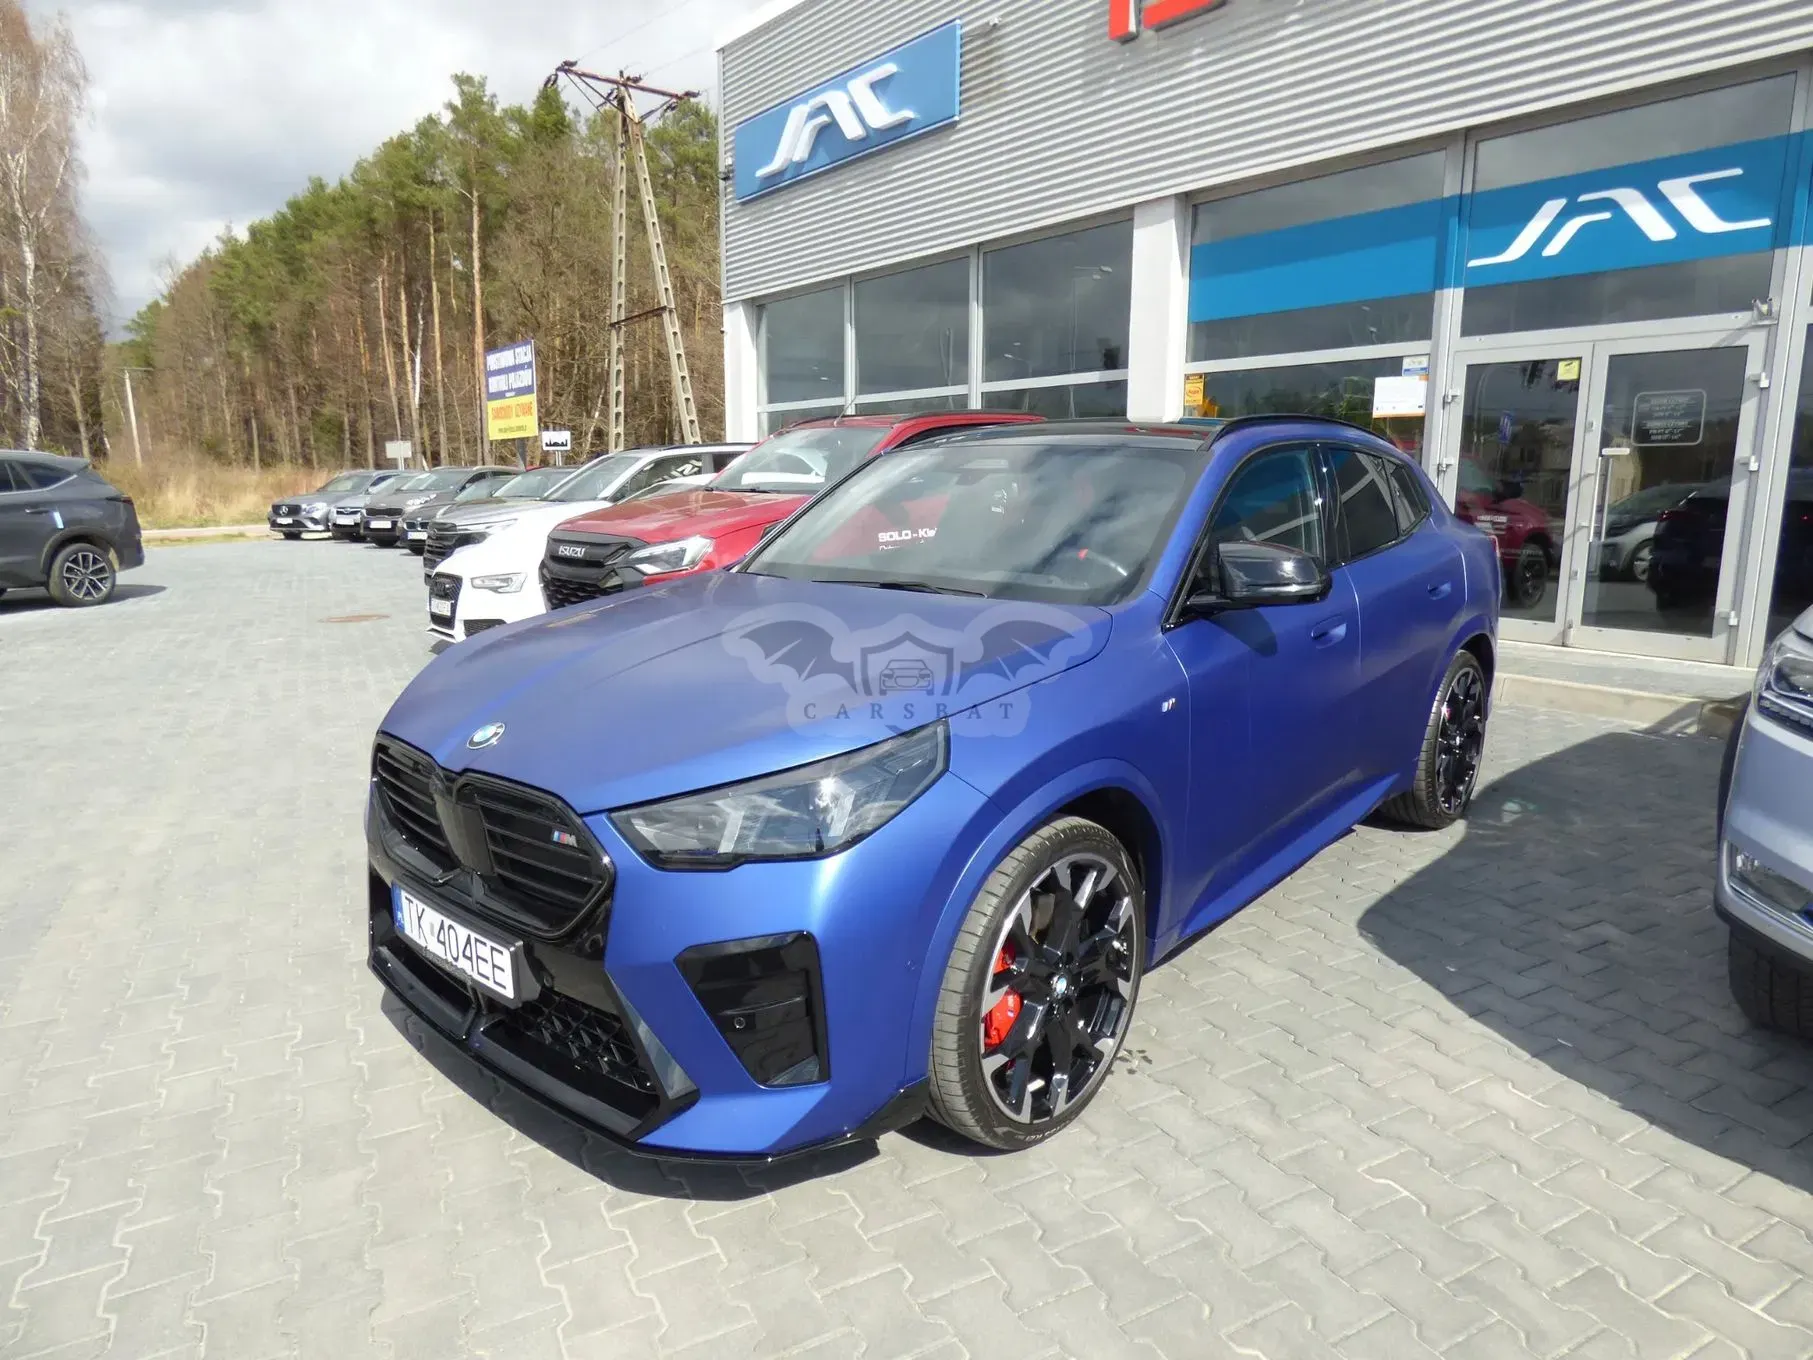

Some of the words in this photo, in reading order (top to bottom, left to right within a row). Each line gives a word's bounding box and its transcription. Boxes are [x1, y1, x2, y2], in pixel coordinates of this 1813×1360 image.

[755, 63, 915, 177] JAC
[1467, 168, 1771, 267] JAC
[559, 545, 585, 558] ISUZU
[405, 896, 428, 946] TK
[437, 919, 507, 990] 404EE
